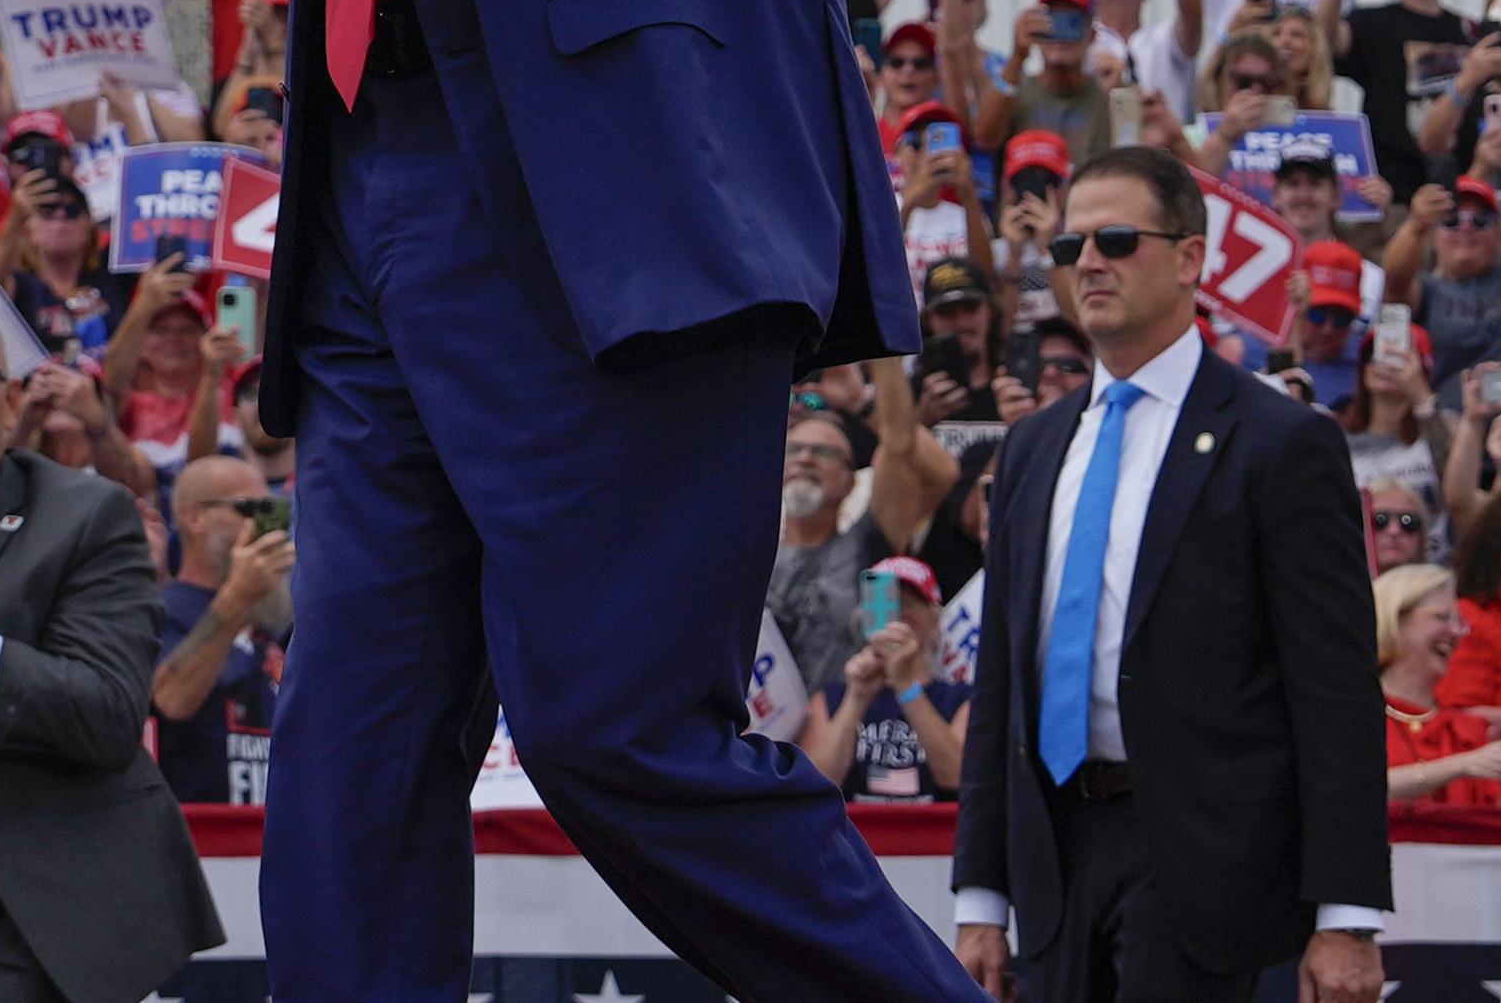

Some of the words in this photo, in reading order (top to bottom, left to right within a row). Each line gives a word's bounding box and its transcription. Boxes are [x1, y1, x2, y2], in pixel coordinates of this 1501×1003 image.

[11, 4, 154, 40] TRUMP
[37, 31, 146, 59] VANCE
[161, 169, 222, 193] PEA
